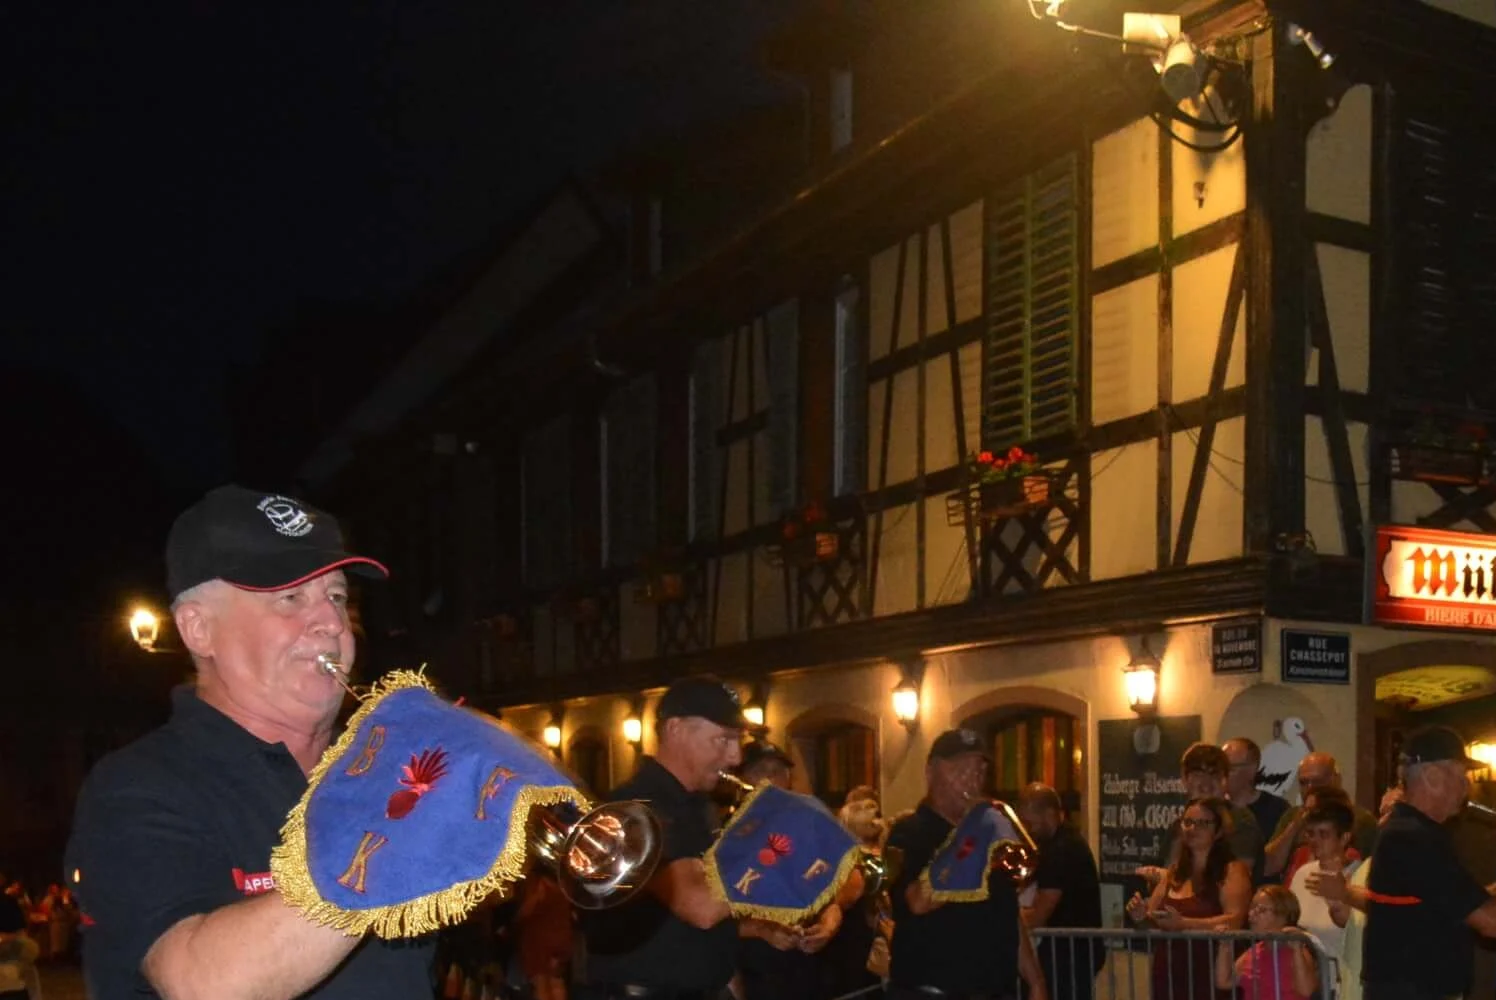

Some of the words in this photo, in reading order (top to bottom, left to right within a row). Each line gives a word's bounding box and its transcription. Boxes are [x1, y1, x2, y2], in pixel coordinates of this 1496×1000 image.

[1289, 649, 1346, 664] CHASSEPOT
[1308, 636, 1328, 650] RUE
[345, 725, 386, 776] B
[336, 830, 389, 895] K
[732, 865, 764, 896] K
